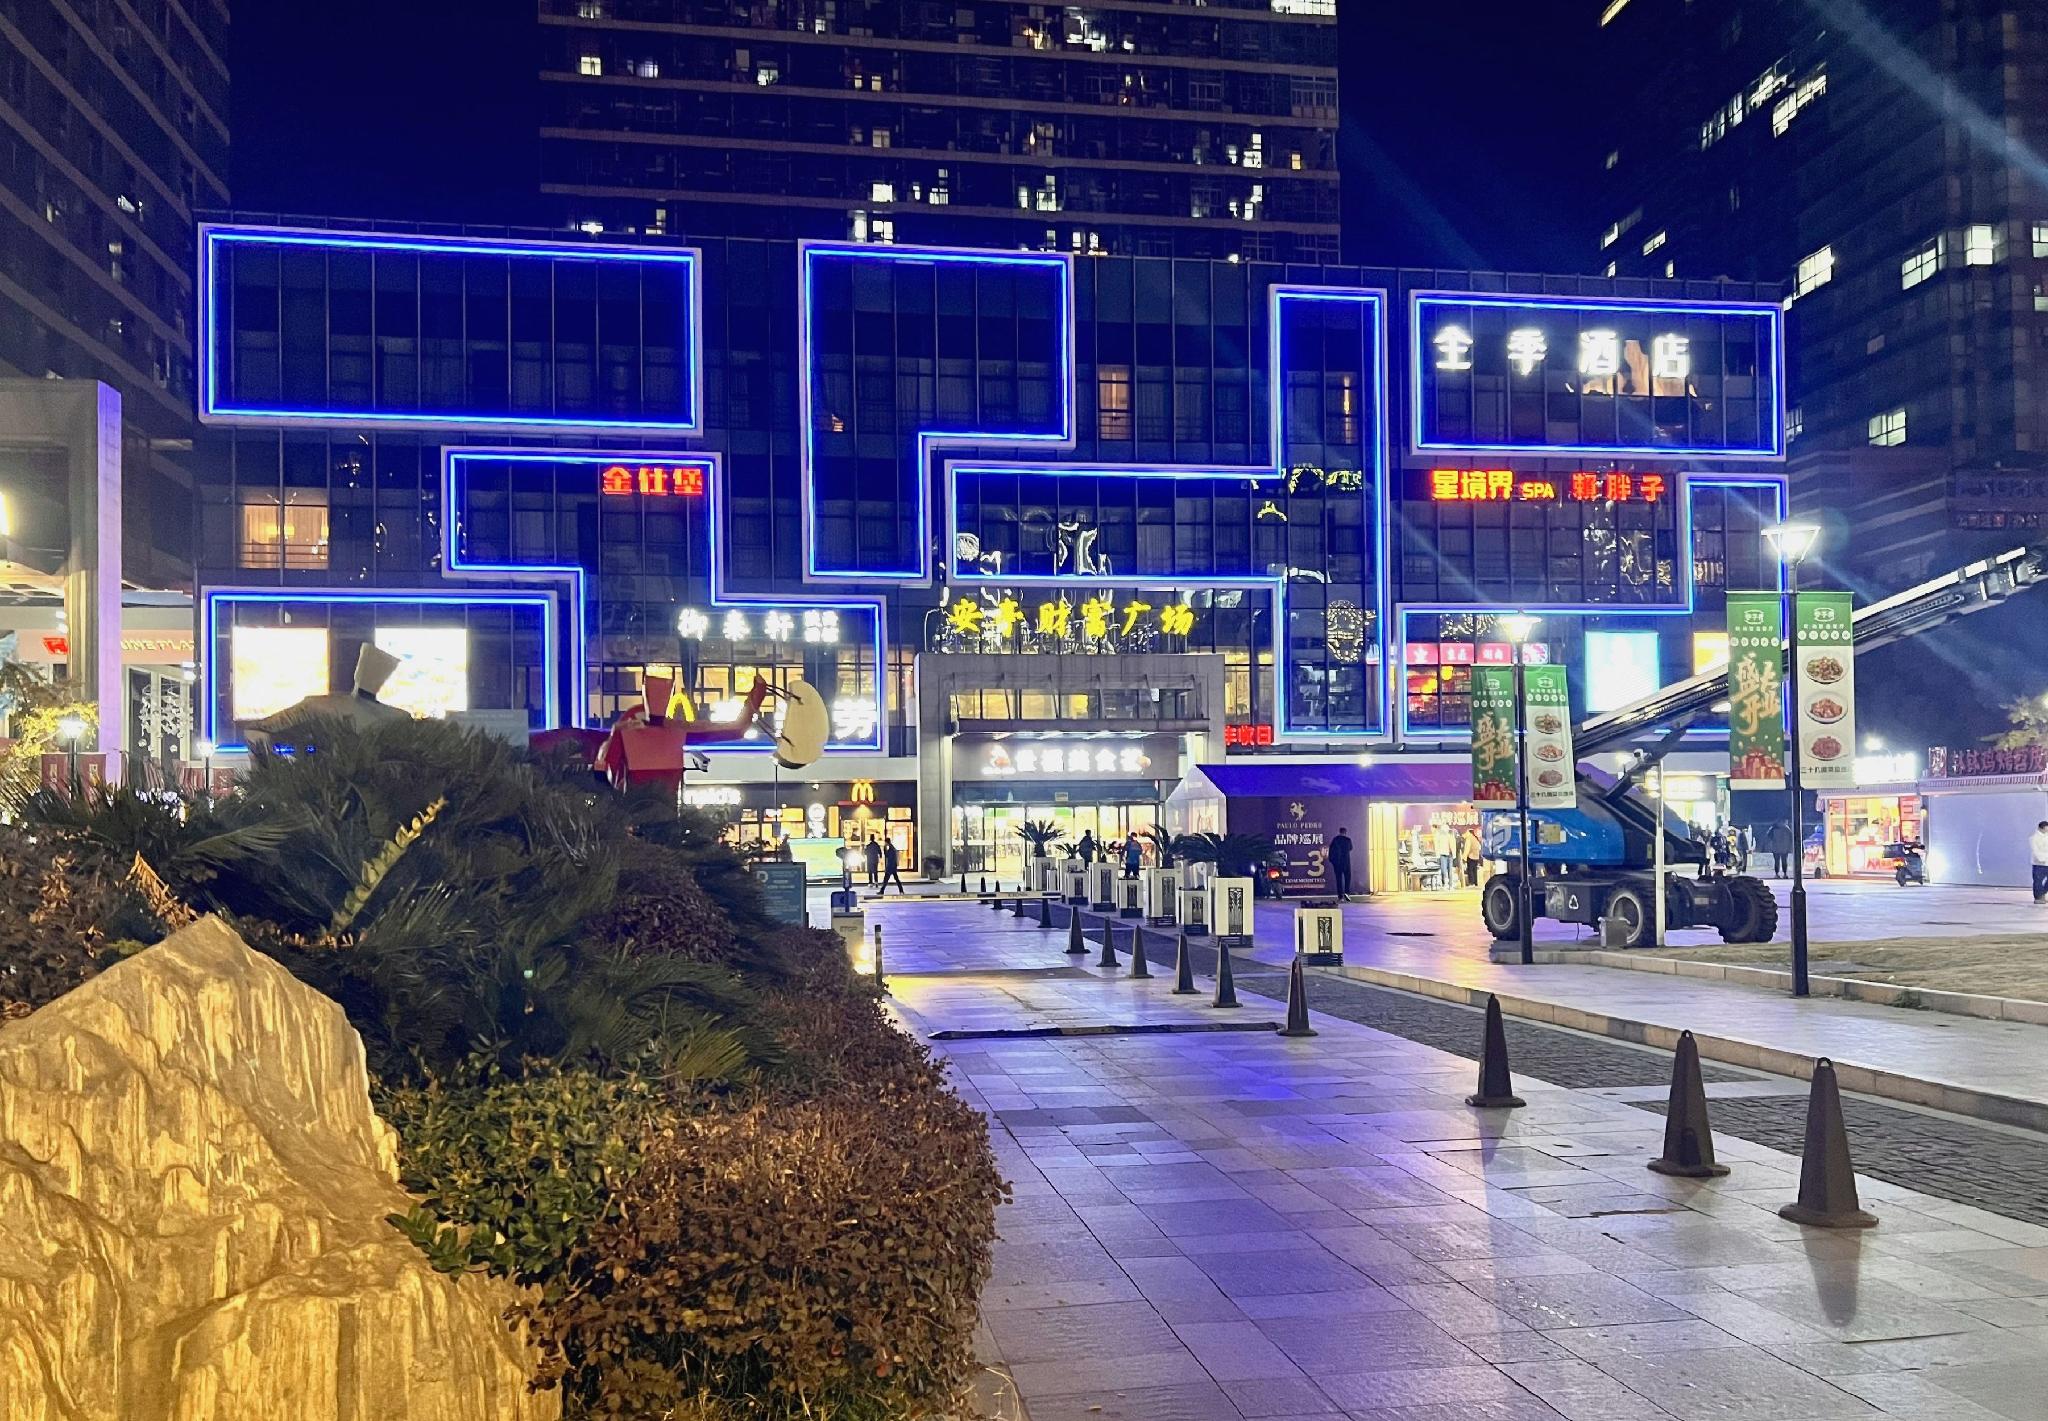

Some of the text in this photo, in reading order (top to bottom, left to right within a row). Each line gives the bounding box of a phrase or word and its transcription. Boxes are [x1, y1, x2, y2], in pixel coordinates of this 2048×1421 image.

[1432, 325, 1690, 378] 全季酒店
[1522, 482, 1555, 499] SPA
[1274, 833, 1324, 845] 品牌巡展
